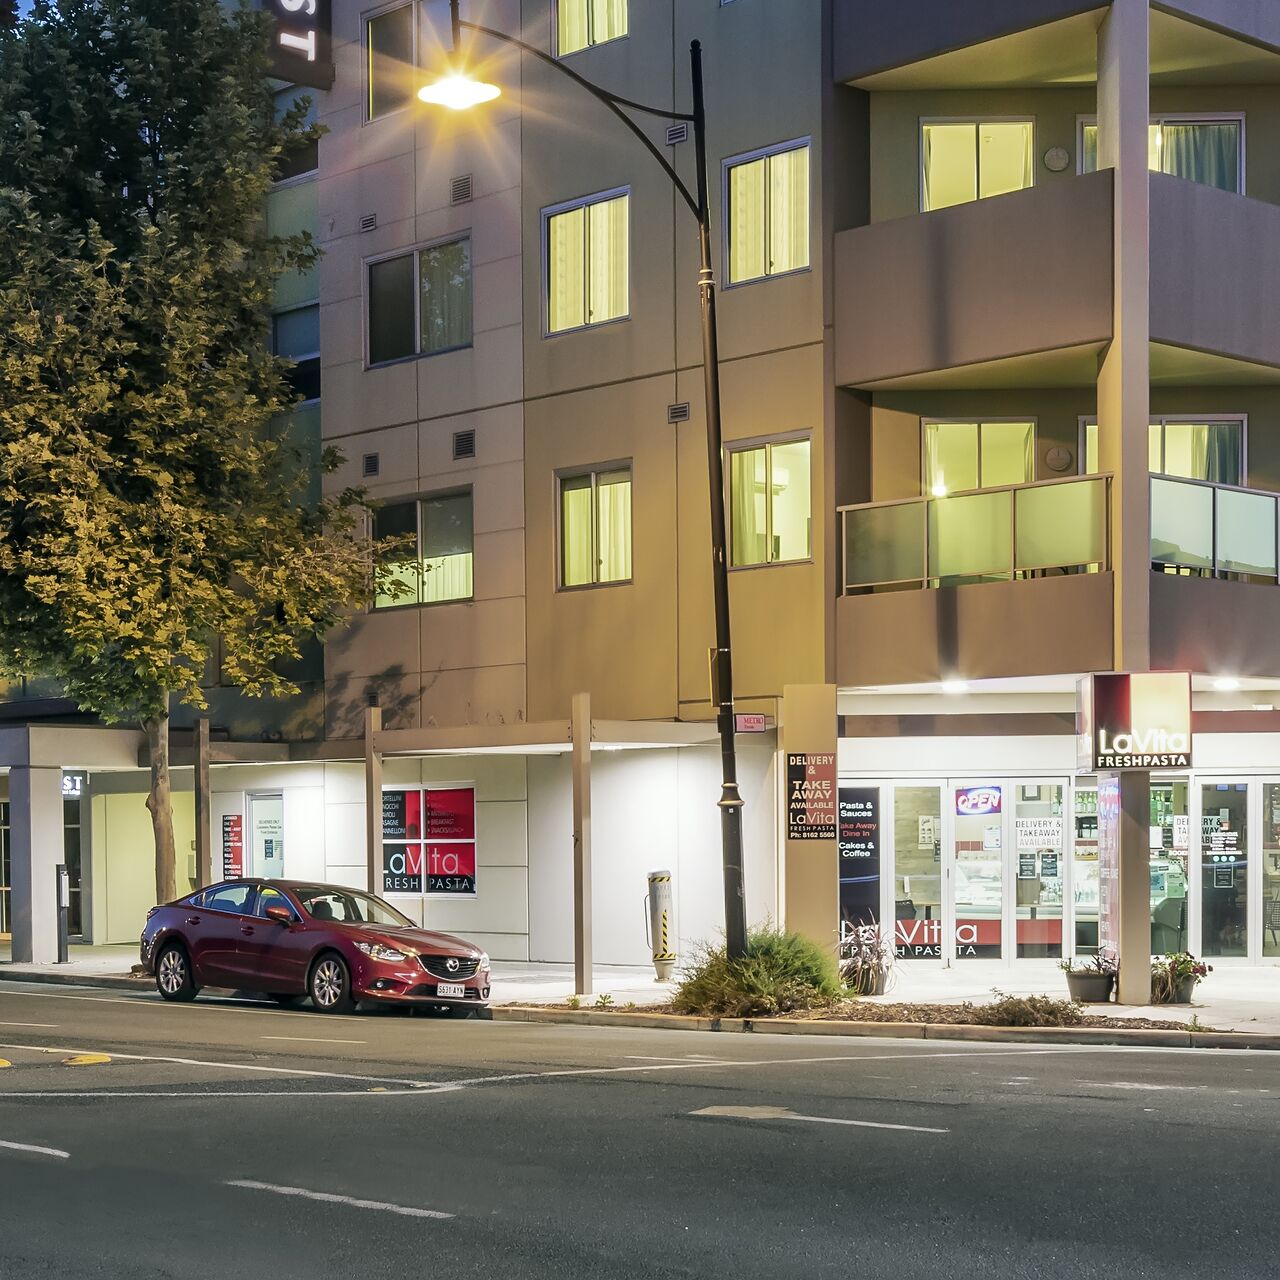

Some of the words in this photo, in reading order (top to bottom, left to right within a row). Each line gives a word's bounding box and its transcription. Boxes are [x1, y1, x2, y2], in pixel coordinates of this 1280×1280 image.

[1099, 729, 1187, 754] LaVita
[789, 756, 834, 765] DELIVERY
[808, 765, 816, 774] &
[792, 781, 831, 789] TAKE
[792, 790, 832, 799] AWAY
[957, 793, 1000, 809] OPEN
[789, 812, 835, 824] LaVita
[855, 823, 877, 831] Away
[1016, 820, 1052, 828] DELIVERY
[1056, 820, 1061, 828] &
[1019, 829, 1060, 837] TAKEAWAY
[1178, 827, 1220, 835] TAWAY
[1020, 838, 1060, 846] AVAILABLE
[383, 847, 459, 875] aVita
[385, 877, 419, 889] RESH
[429, 878, 470, 889] PASTA
